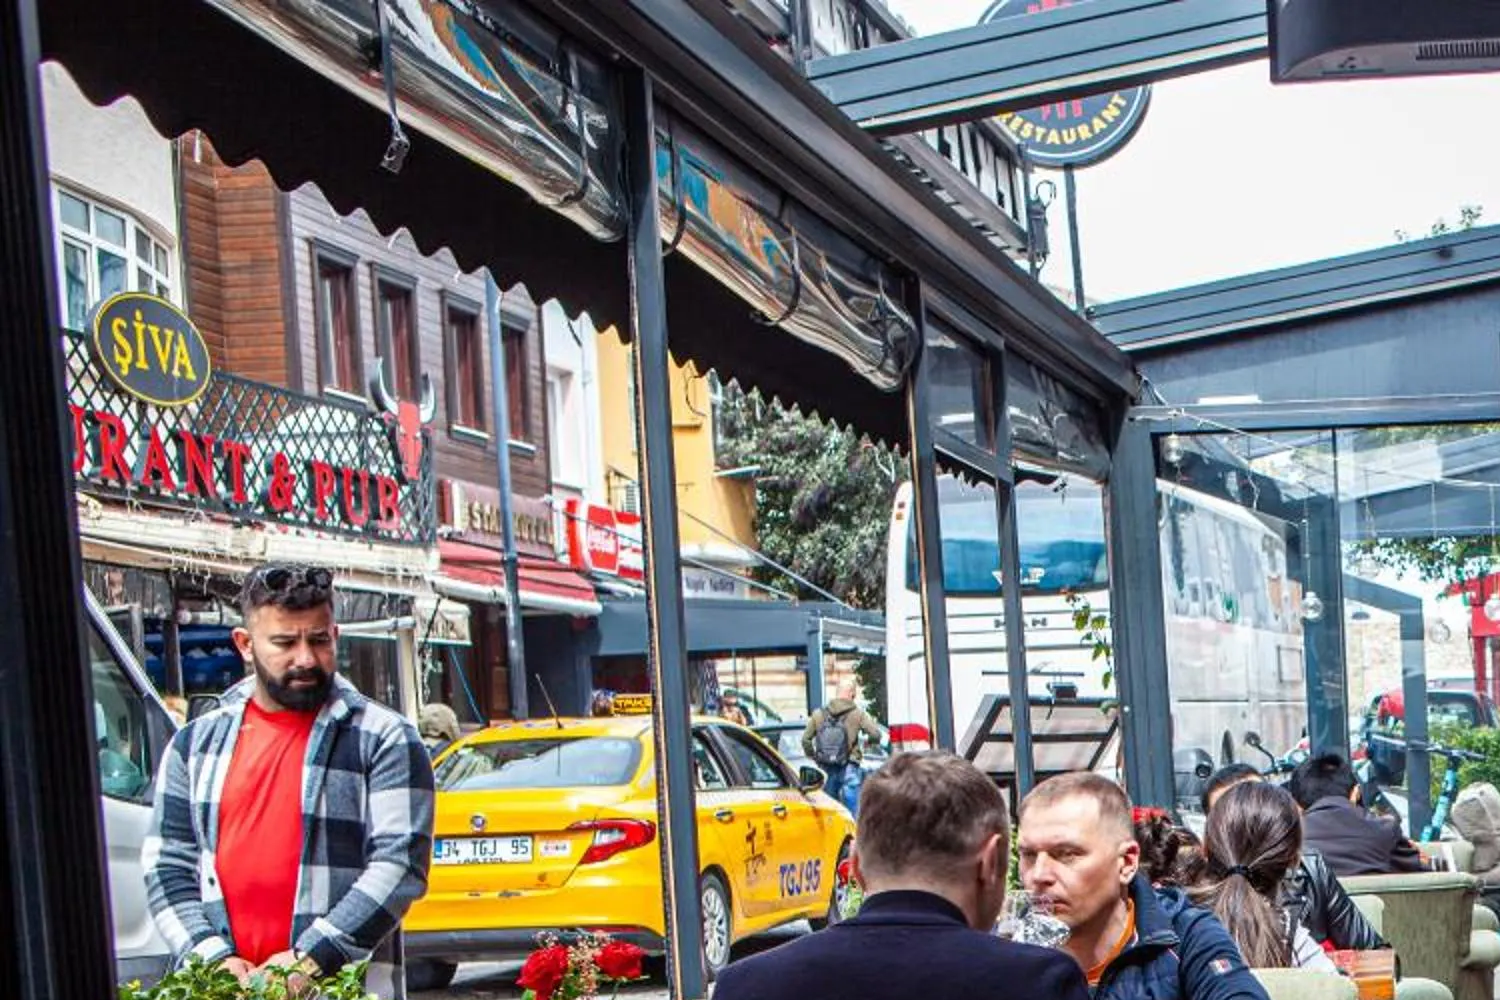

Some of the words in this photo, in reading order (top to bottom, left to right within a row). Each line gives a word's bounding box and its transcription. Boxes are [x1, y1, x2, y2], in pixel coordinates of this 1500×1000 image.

[111, 309, 197, 381] ŞİVA
[268, 452, 297, 512] &
[312, 460, 401, 530] PUB
[442, 841, 460, 858] 34
[471, 839, 498, 857] TGJ
[511, 838, 529, 856] 95
